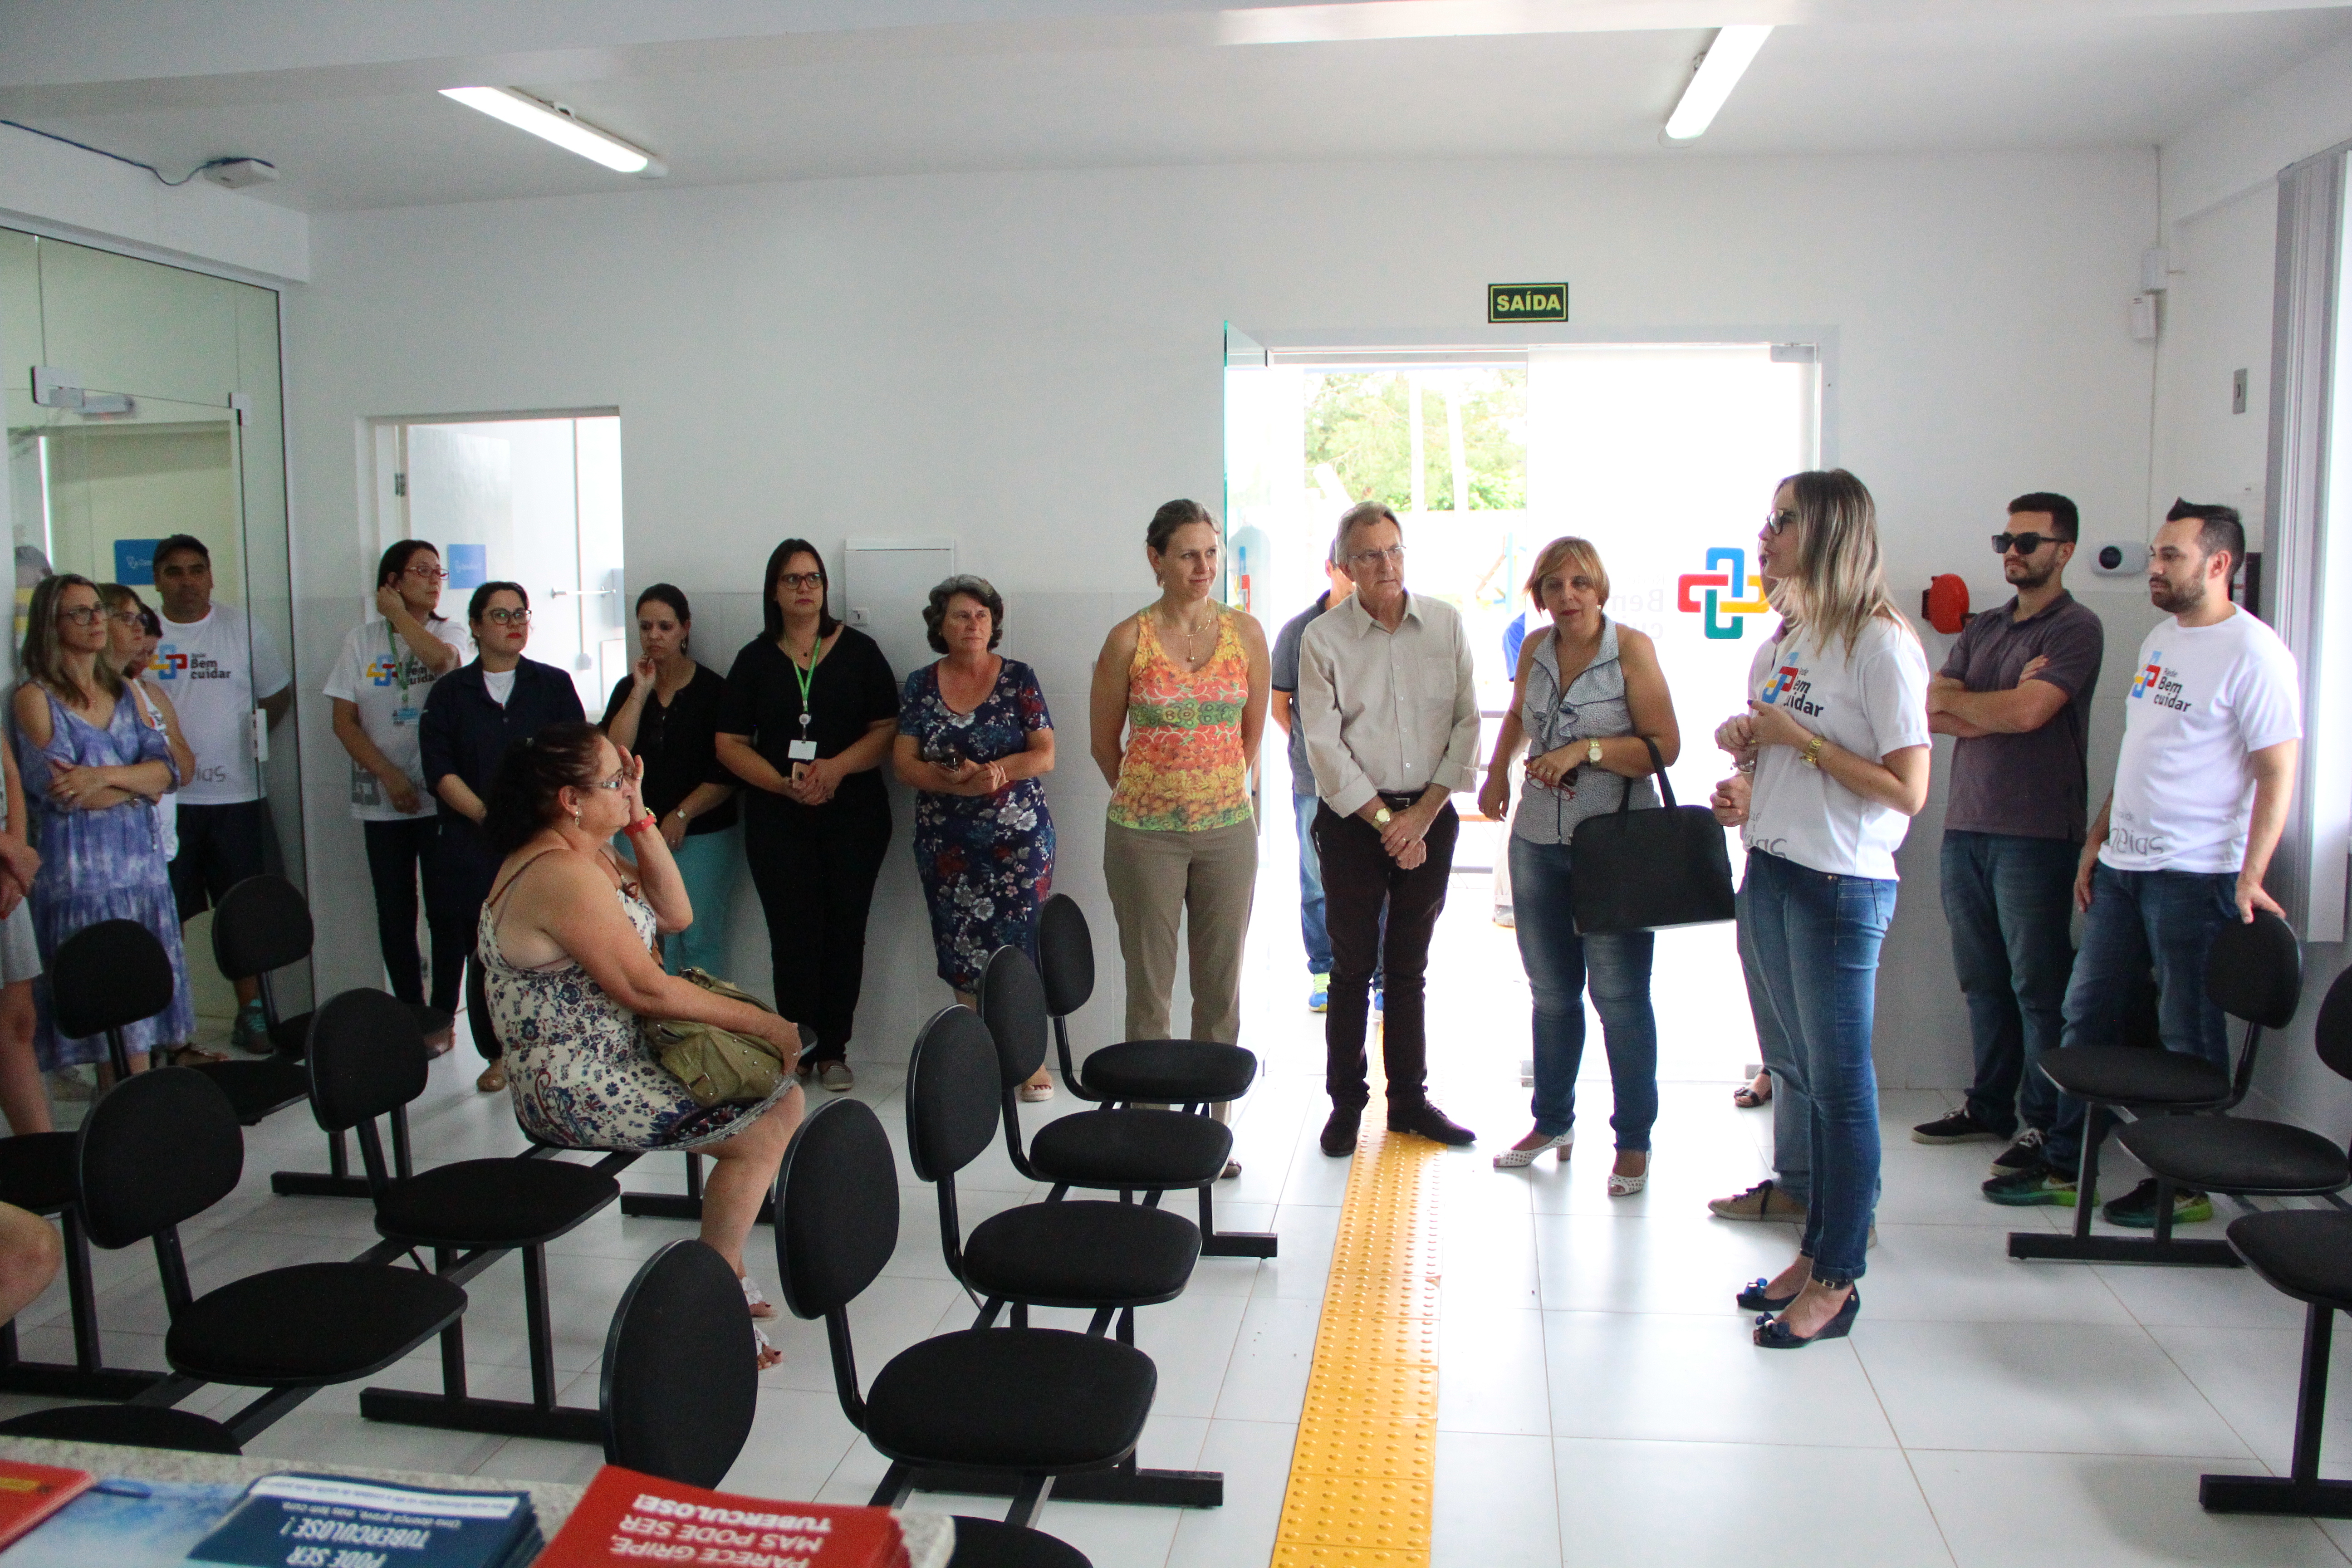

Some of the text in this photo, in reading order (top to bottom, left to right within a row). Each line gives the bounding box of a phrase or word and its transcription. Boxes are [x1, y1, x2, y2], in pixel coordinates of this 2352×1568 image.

[1497, 291, 1561, 311] SAÍDA
[191, 658, 217, 669] Bem
[191, 668, 231, 679] cuidar
[1793, 679, 1811, 694] em
[2158, 676, 2183, 694] Bem
[2153, 692, 2192, 712] cuidar
[632, 1493, 832, 1533] TUBERCULOSE!
[618, 1514, 824, 1553] MAS PODE SER
[286, 1545, 331, 1566] SER
